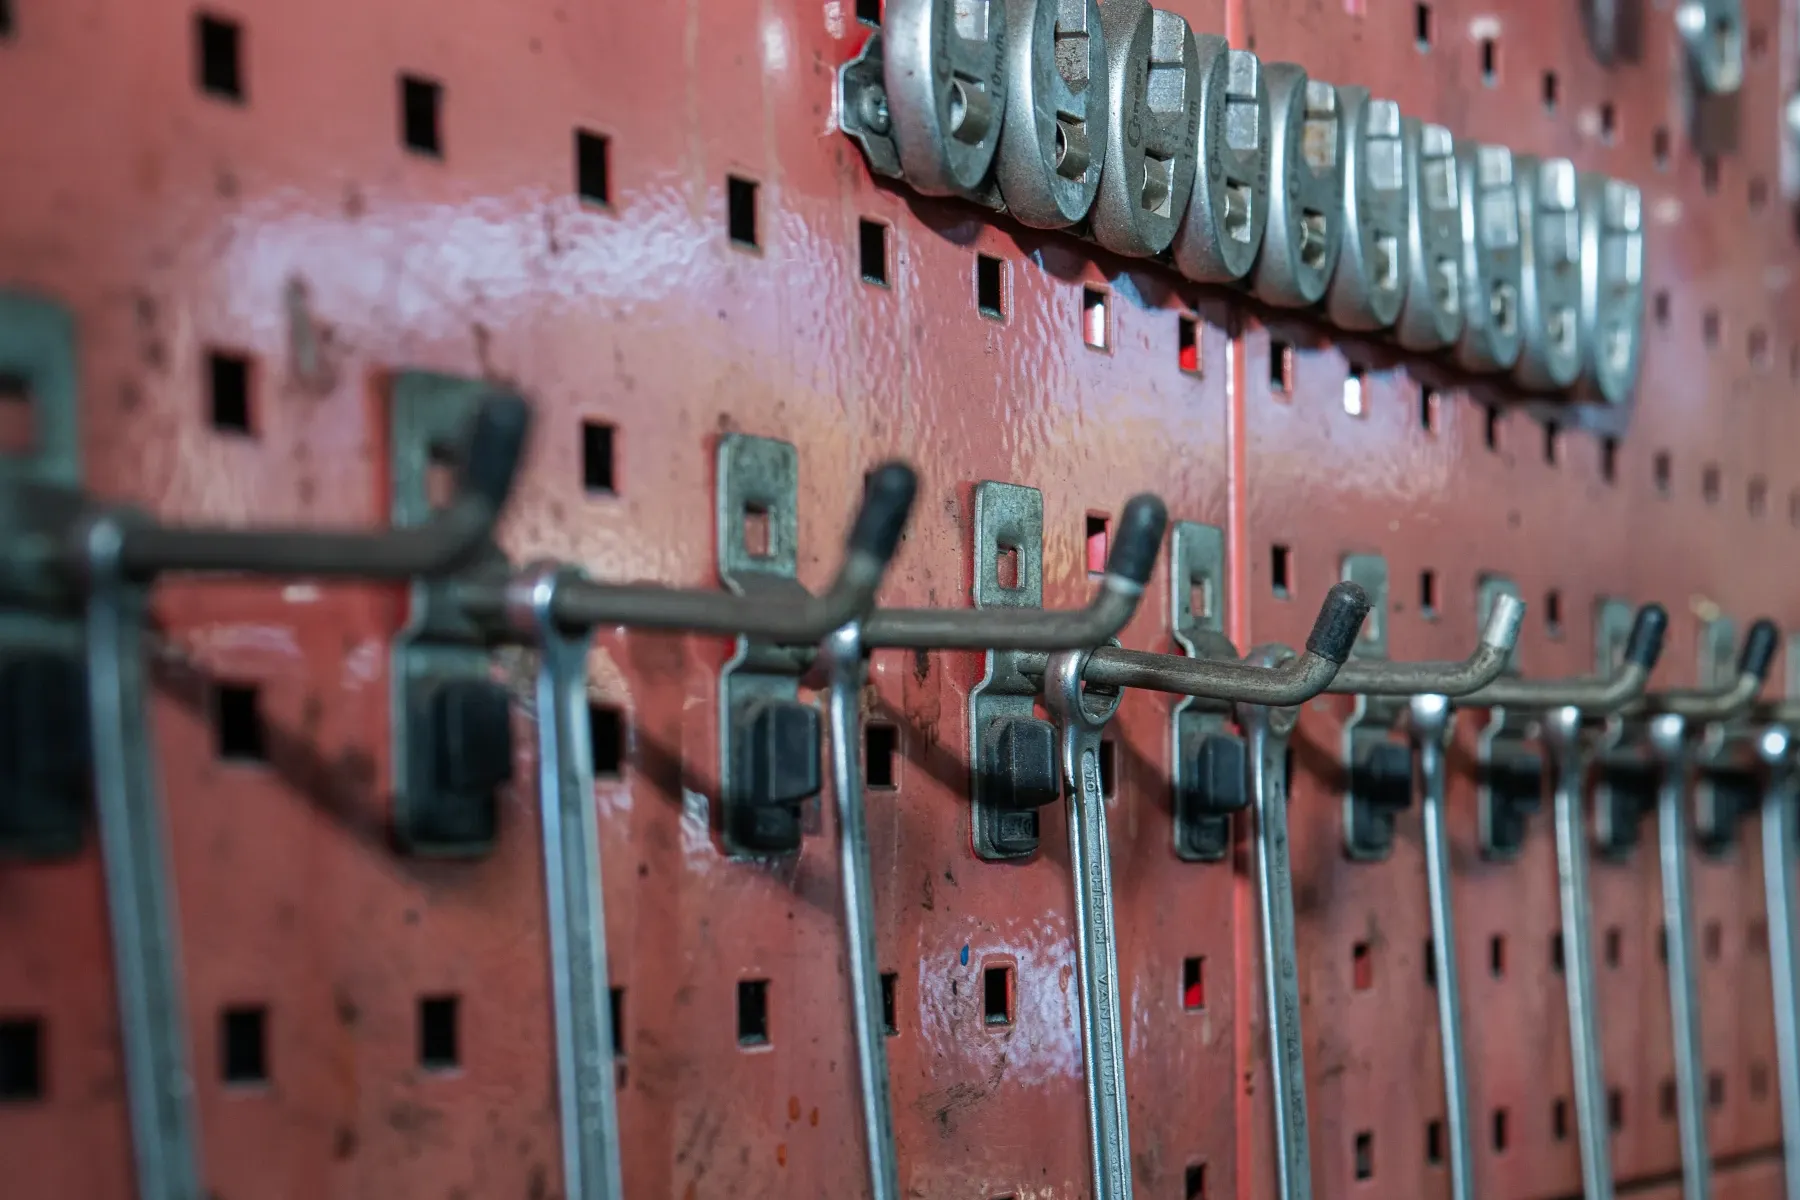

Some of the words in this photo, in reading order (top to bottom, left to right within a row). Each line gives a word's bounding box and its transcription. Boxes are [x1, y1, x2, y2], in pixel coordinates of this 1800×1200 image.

[991, 33, 1004, 98] 10mm
[1183, 100, 1198, 160] 12mm
[1084, 771, 1096, 793] 10
[1090, 861, 1106, 945] CHROM
[1098, 974, 1116, 1097] VANADIUM
